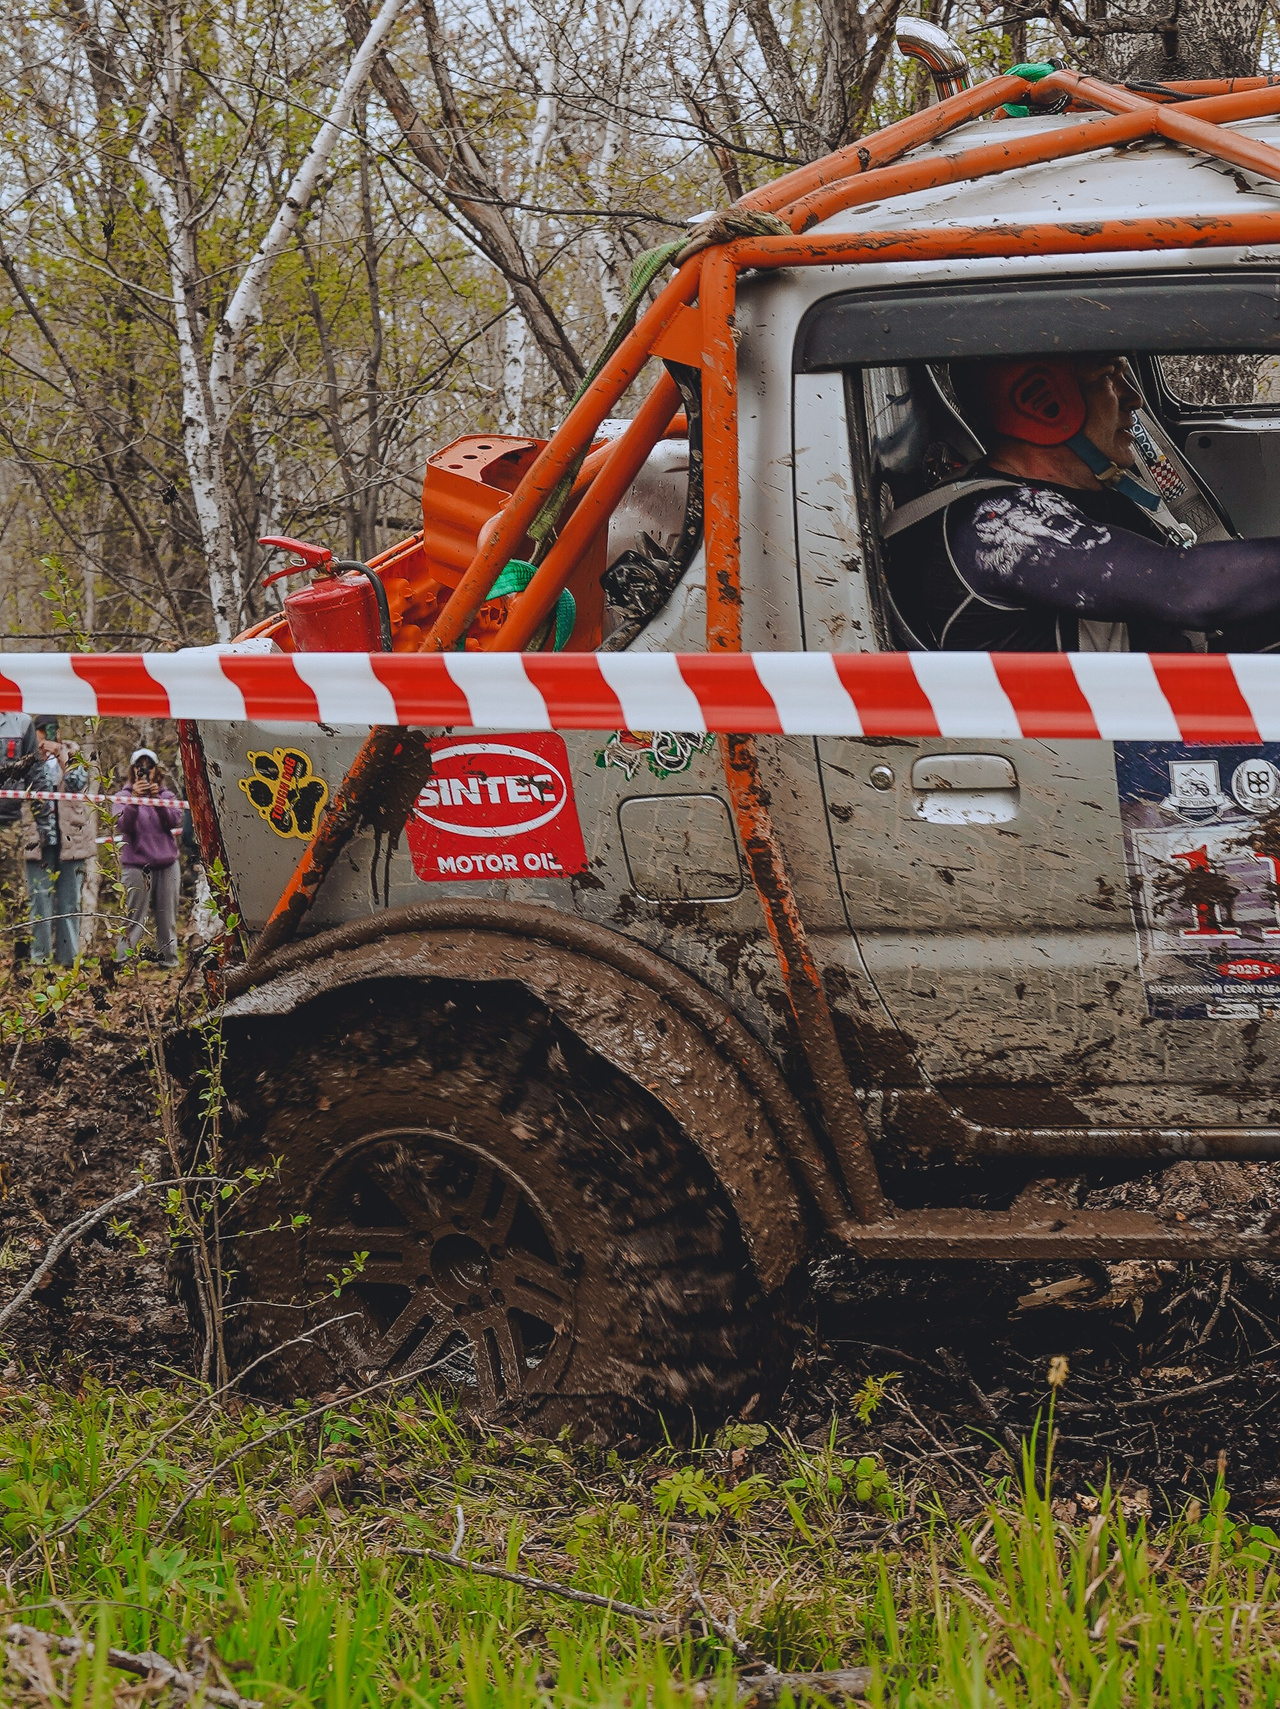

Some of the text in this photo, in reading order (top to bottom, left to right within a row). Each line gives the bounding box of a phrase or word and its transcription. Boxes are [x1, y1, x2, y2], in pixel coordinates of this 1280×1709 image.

[271, 780, 291, 821] TOUGH
[282, 756, 297, 782] DOG
[418, 774, 556, 808] SINTEC
[437, 852, 562, 874] MOTOR OIL
[1227, 964, 1261, 975] 2025
